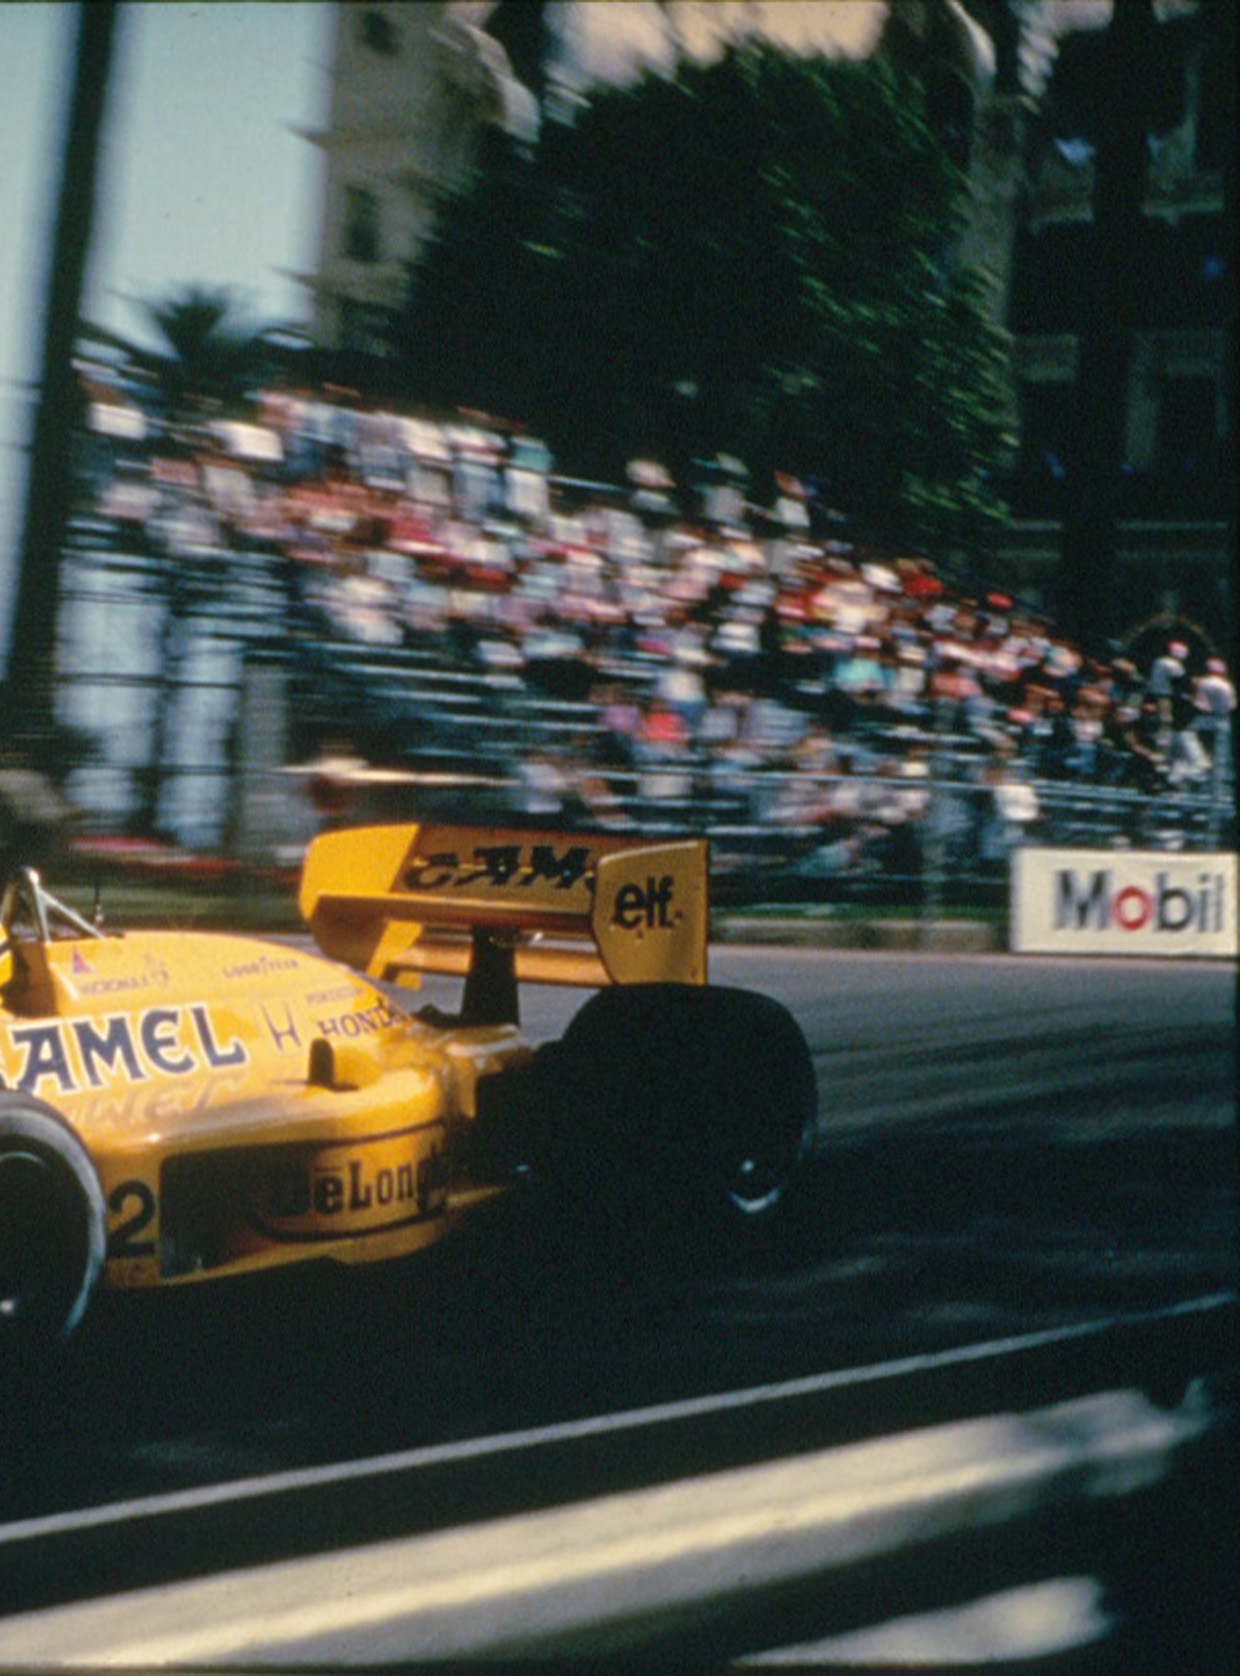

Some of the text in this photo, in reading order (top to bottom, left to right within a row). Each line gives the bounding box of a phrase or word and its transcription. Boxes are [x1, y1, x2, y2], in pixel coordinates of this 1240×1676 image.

[405, 845, 598, 892] CAM
[614, 874, 675, 930] elf
[1051, 868, 1224, 933] Mobil
[107, 1179, 156, 1258] 2
